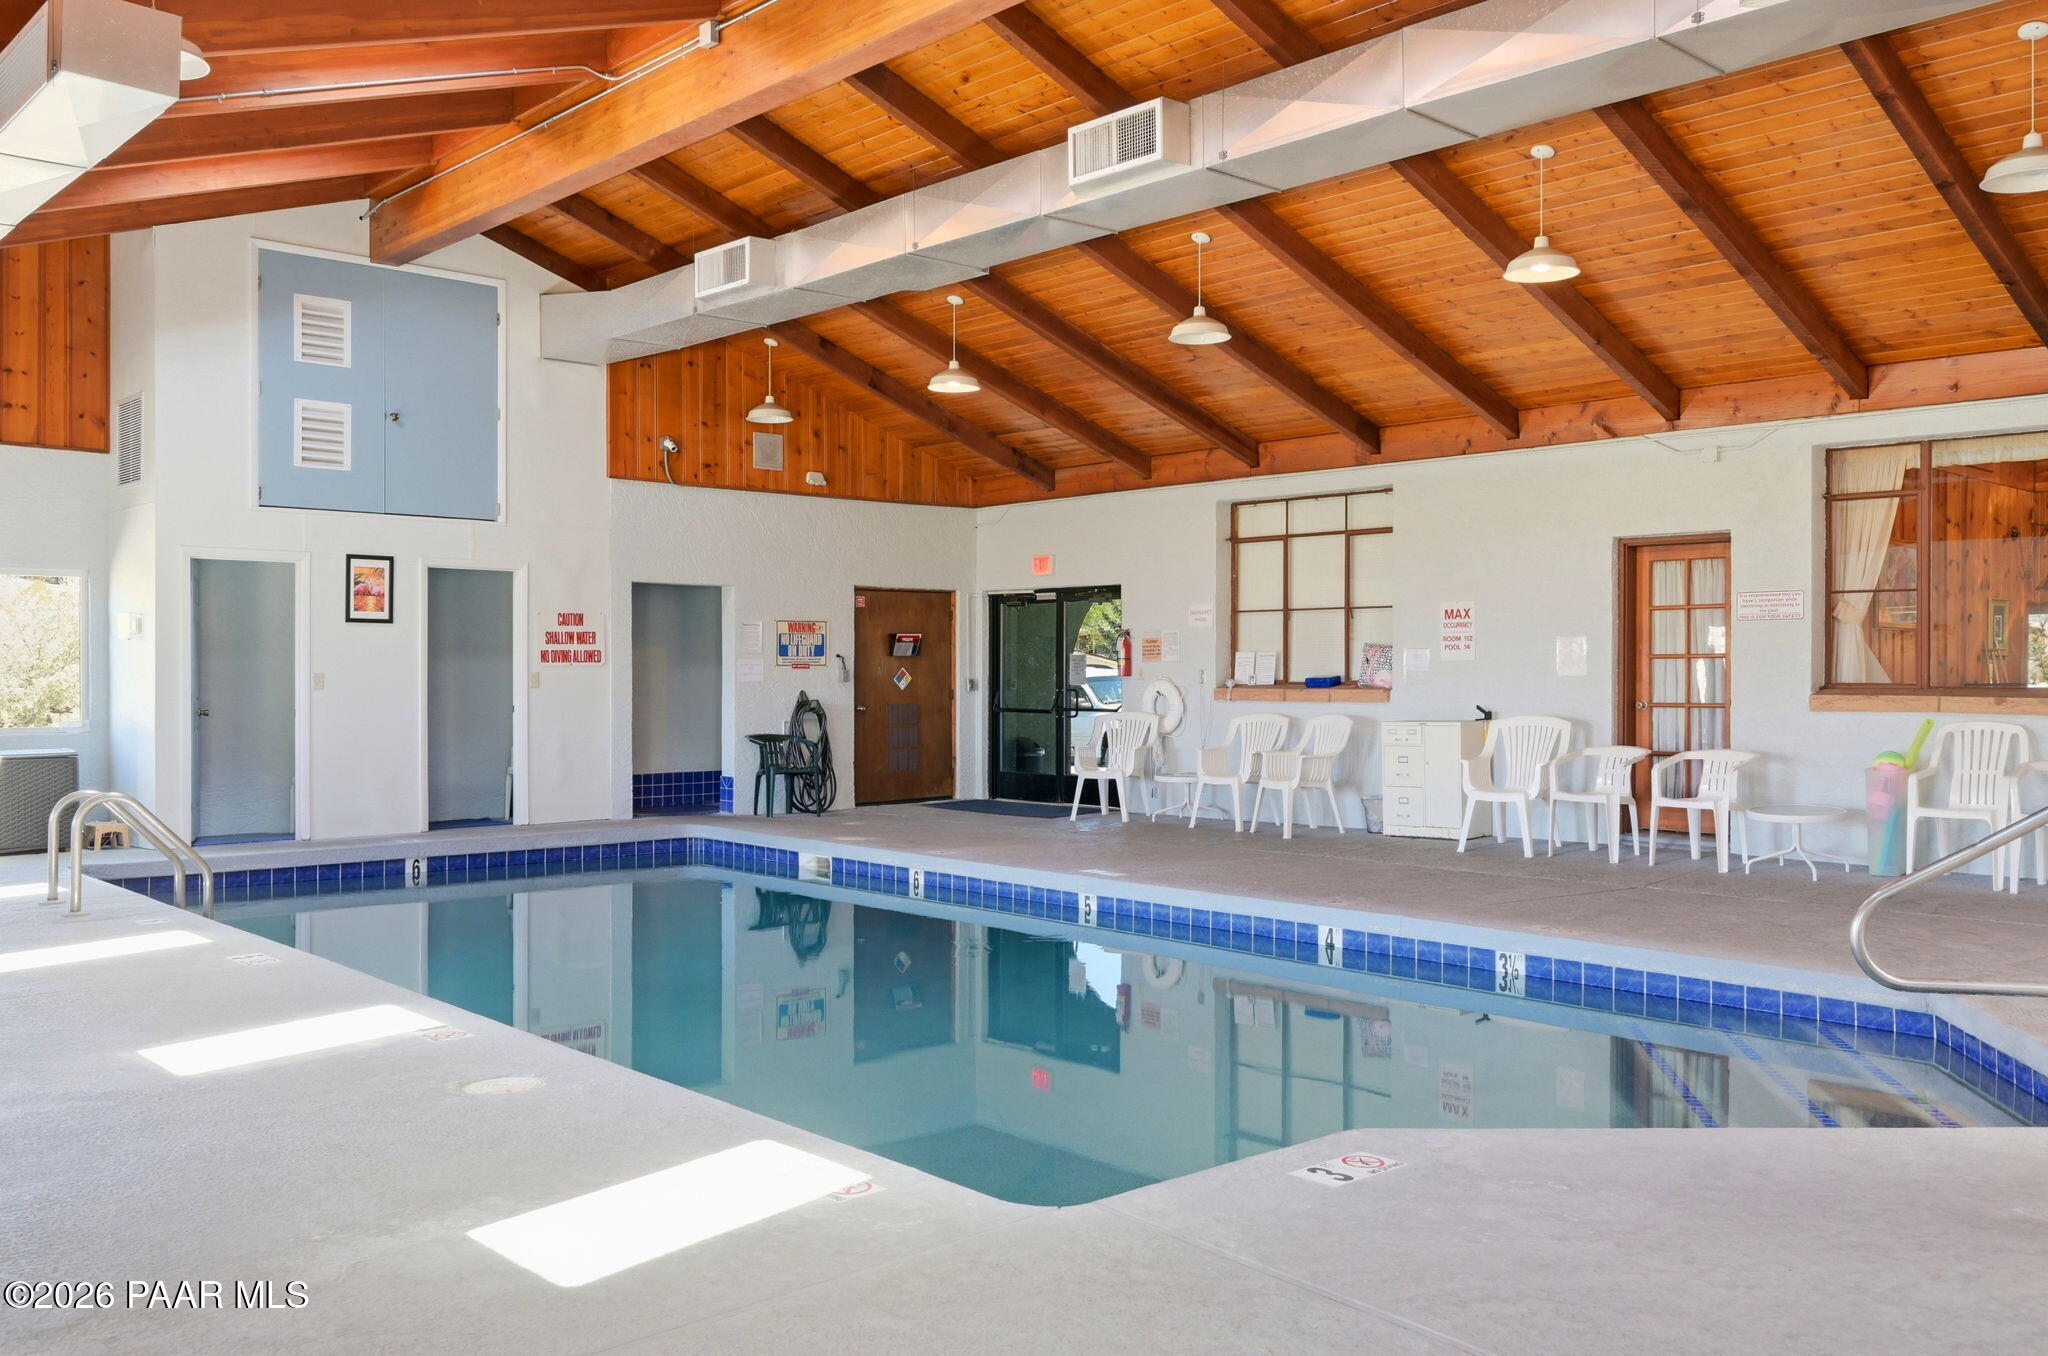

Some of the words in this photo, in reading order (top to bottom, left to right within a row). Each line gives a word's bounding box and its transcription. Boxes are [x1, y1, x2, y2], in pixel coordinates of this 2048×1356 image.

[557, 612, 584, 627] CAUTION
[1444, 608, 1471, 620] MAX
[787, 622, 816, 633] WARNING
[545, 631, 574, 645] SHALLOW
[576, 631, 597, 645] WATER
[541, 650, 549, 663] NO
[551, 650, 572, 663] DIVING
[573, 650, 602, 663] ALLOWED
[798, 645, 815, 656] DUTY
[1324, 927, 1335, 947] 4
